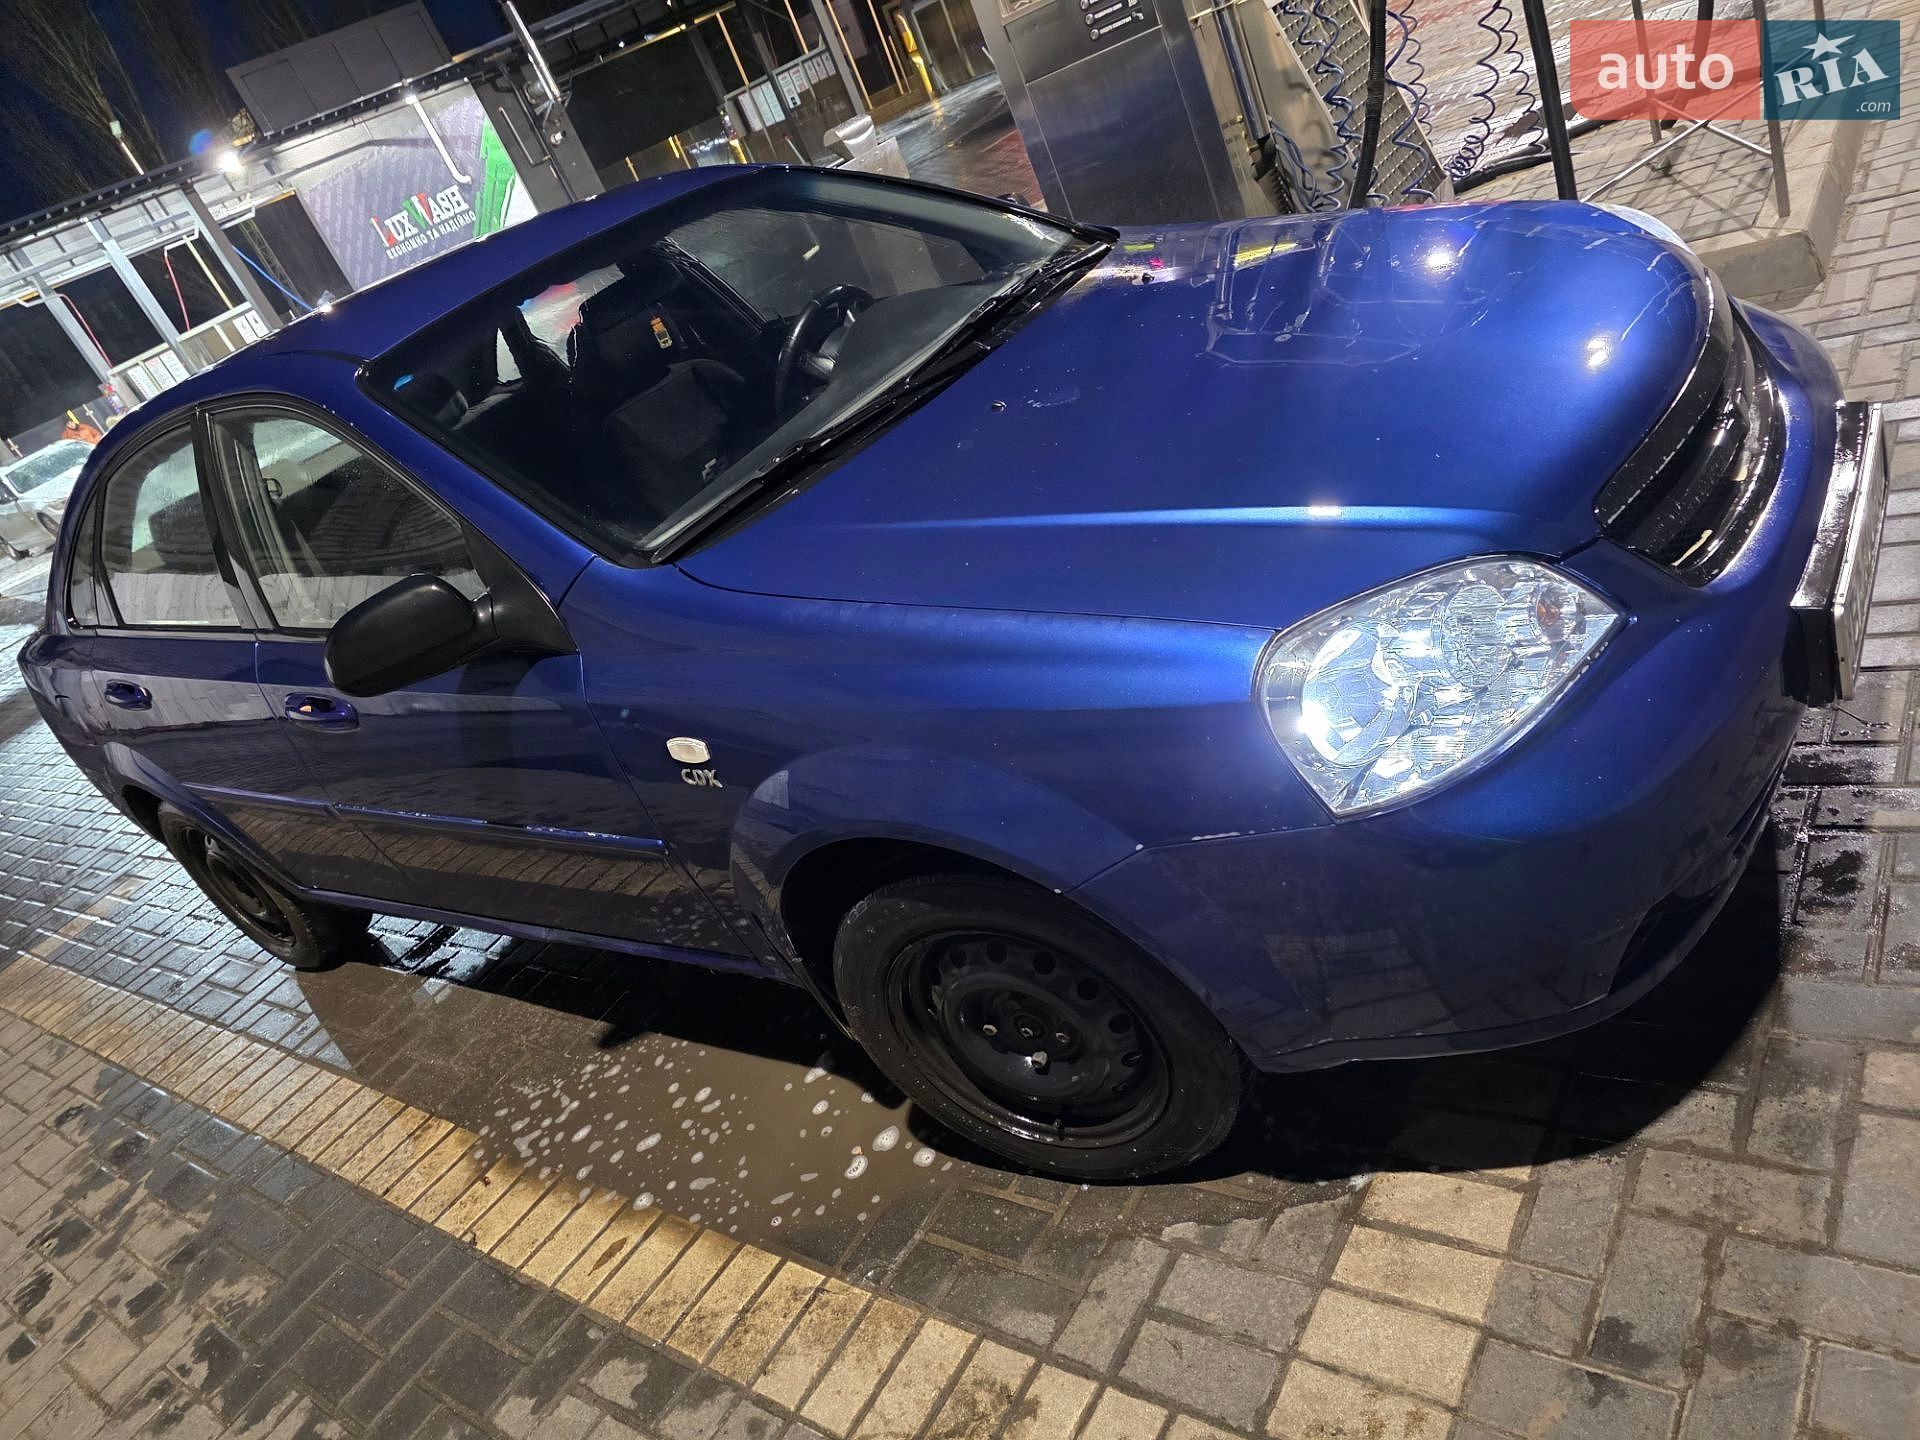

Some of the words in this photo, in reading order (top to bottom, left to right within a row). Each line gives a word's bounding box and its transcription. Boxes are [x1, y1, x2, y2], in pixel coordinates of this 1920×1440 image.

[386, 234, 427, 259] ЕКОНОМНО
[426, 228, 440, 240] ТА
[681, 768, 723, 788] CDX
